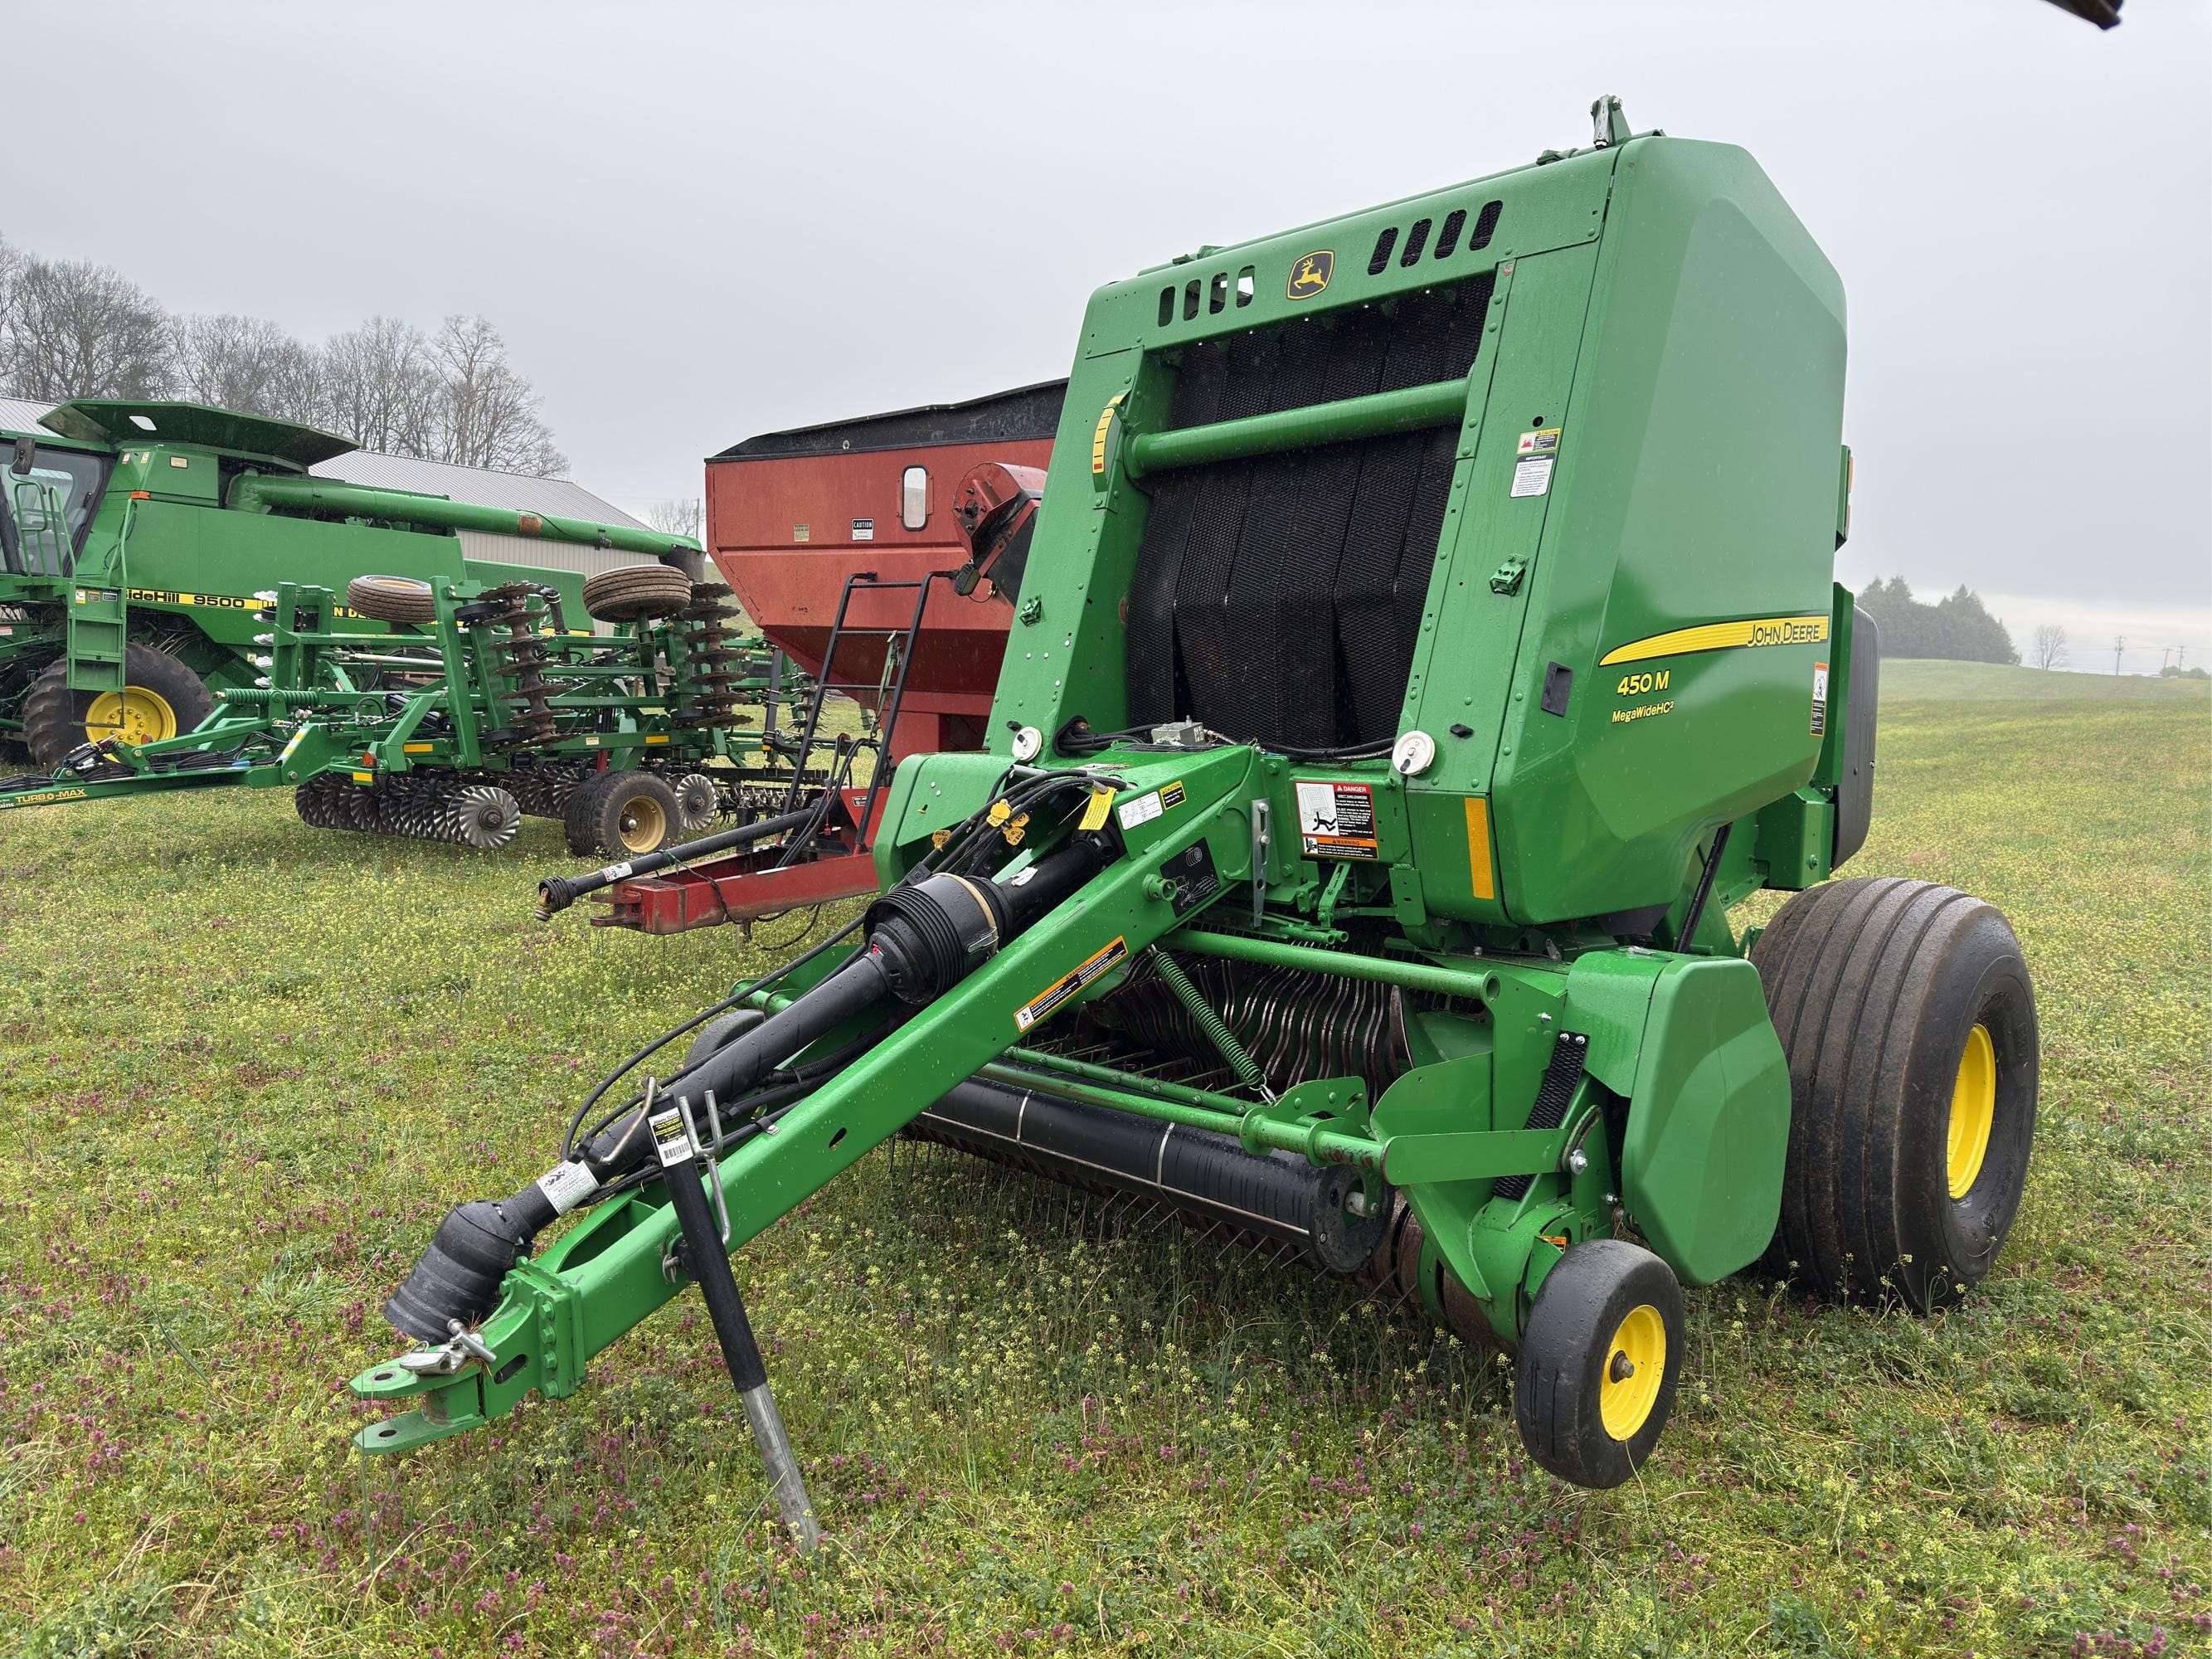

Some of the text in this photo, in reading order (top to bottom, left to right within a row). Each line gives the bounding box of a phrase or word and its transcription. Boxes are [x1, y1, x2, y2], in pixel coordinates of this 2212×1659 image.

[126, 589, 179, 603] ideHill
[193, 595, 245, 607] 9500
[1747, 621, 1821, 645] JOHN DEERE
[1616, 669, 1670, 697] 450 M
